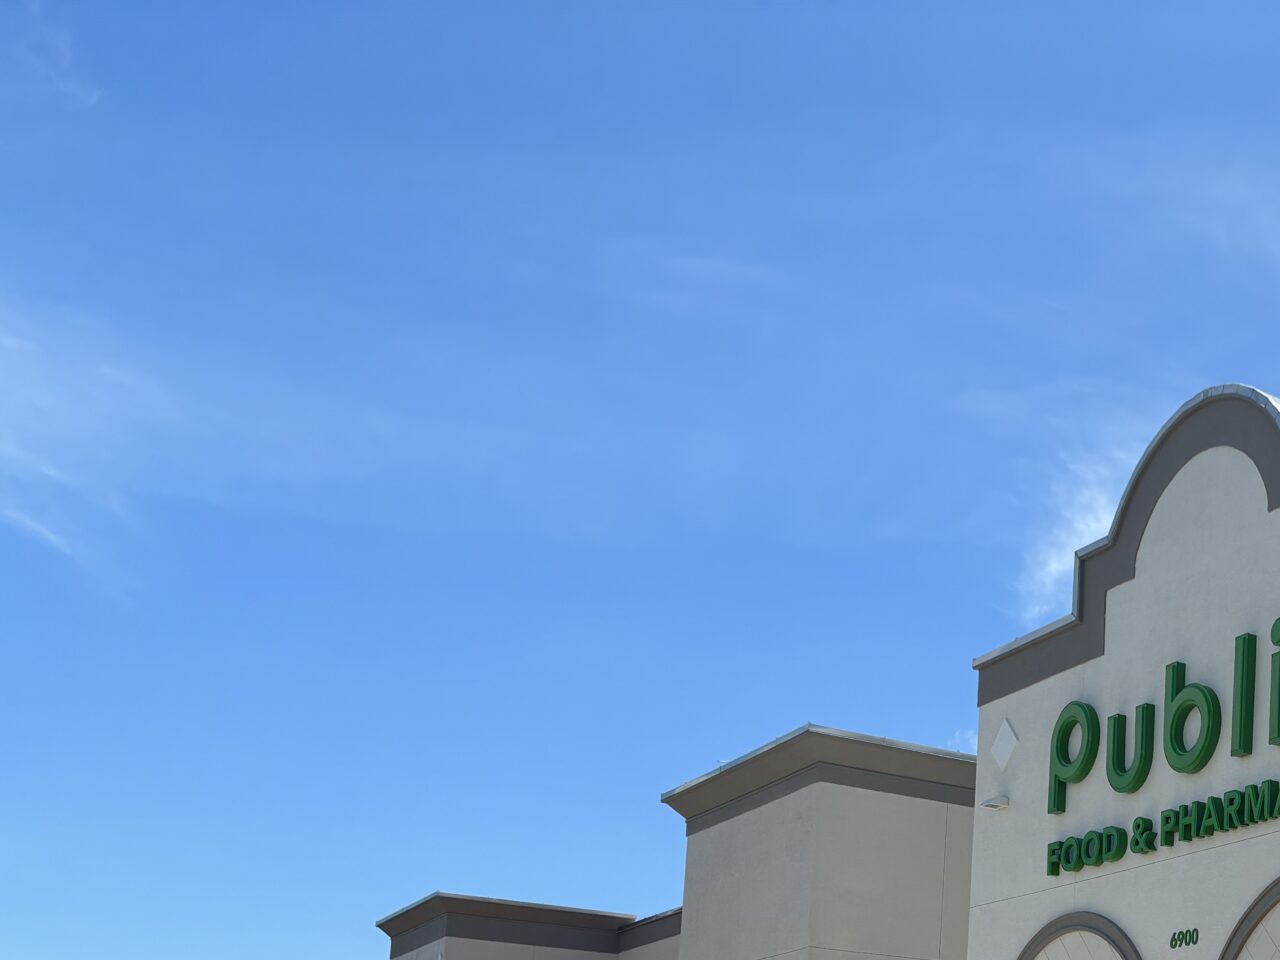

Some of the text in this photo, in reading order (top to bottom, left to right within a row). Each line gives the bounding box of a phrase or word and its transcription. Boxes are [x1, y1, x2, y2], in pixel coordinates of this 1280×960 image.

[1047, 825, 1129, 877] FOOD
[1130, 816, 1157, 855] &
[1169, 927, 1200, 950] 6900
